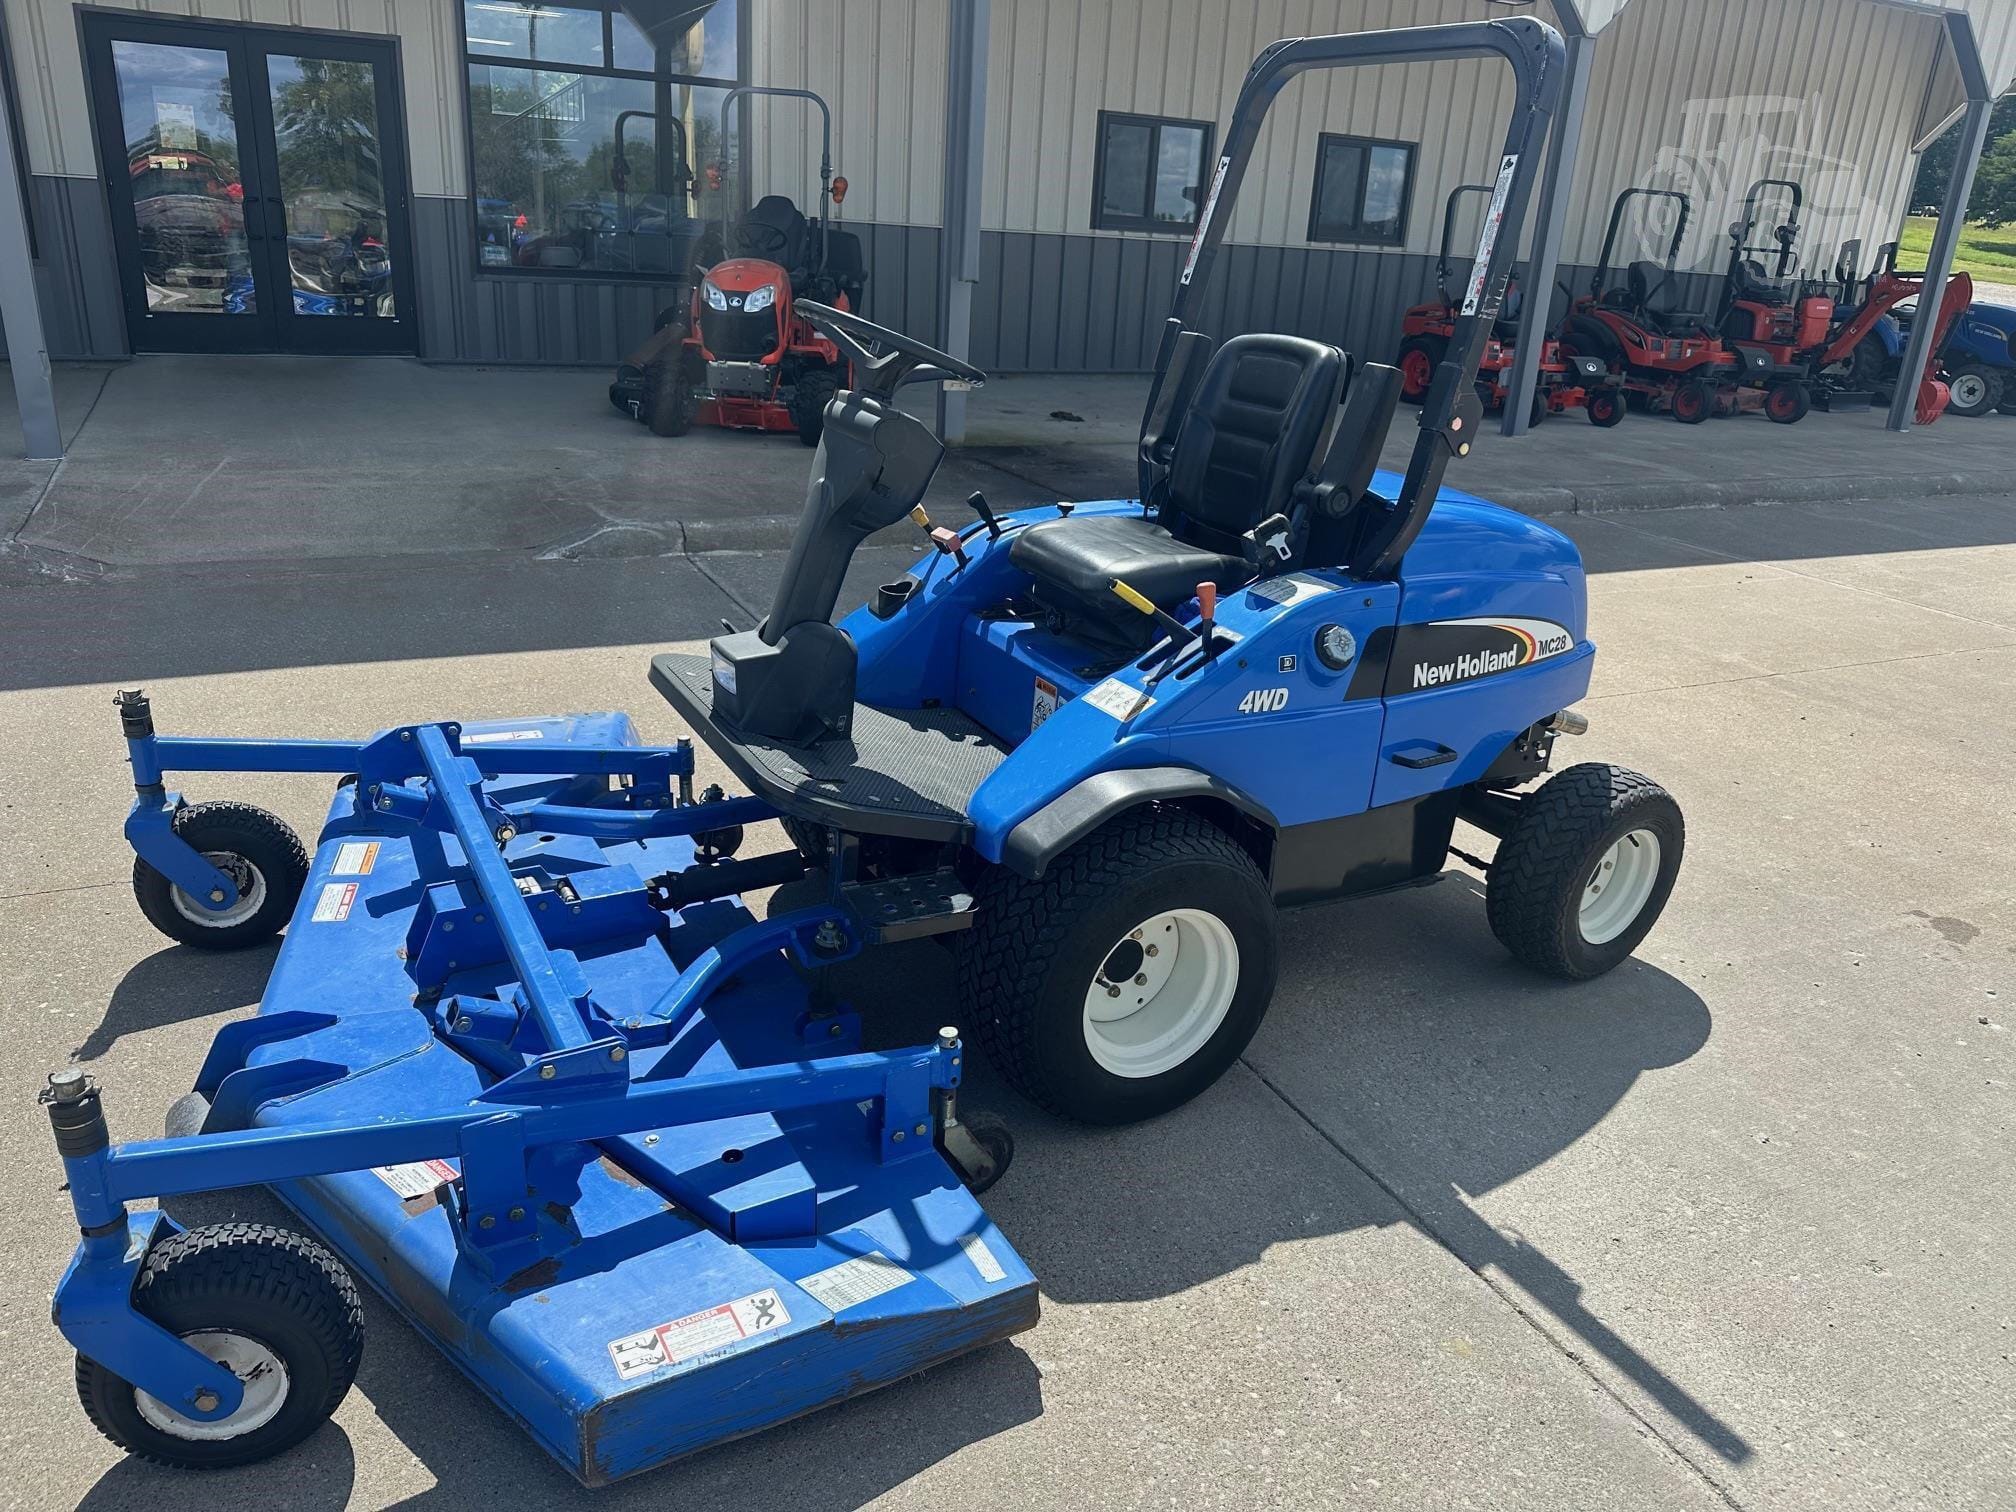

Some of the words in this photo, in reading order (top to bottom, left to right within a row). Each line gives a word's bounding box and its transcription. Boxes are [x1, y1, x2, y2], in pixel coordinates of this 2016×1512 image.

[1537, 634, 1567, 657] MC28
[1412, 661, 1456, 688] New
[1456, 643, 1518, 680] Holland
[1238, 688, 1289, 714] 4WD
[678, 1309, 718, 1328] DANGER
